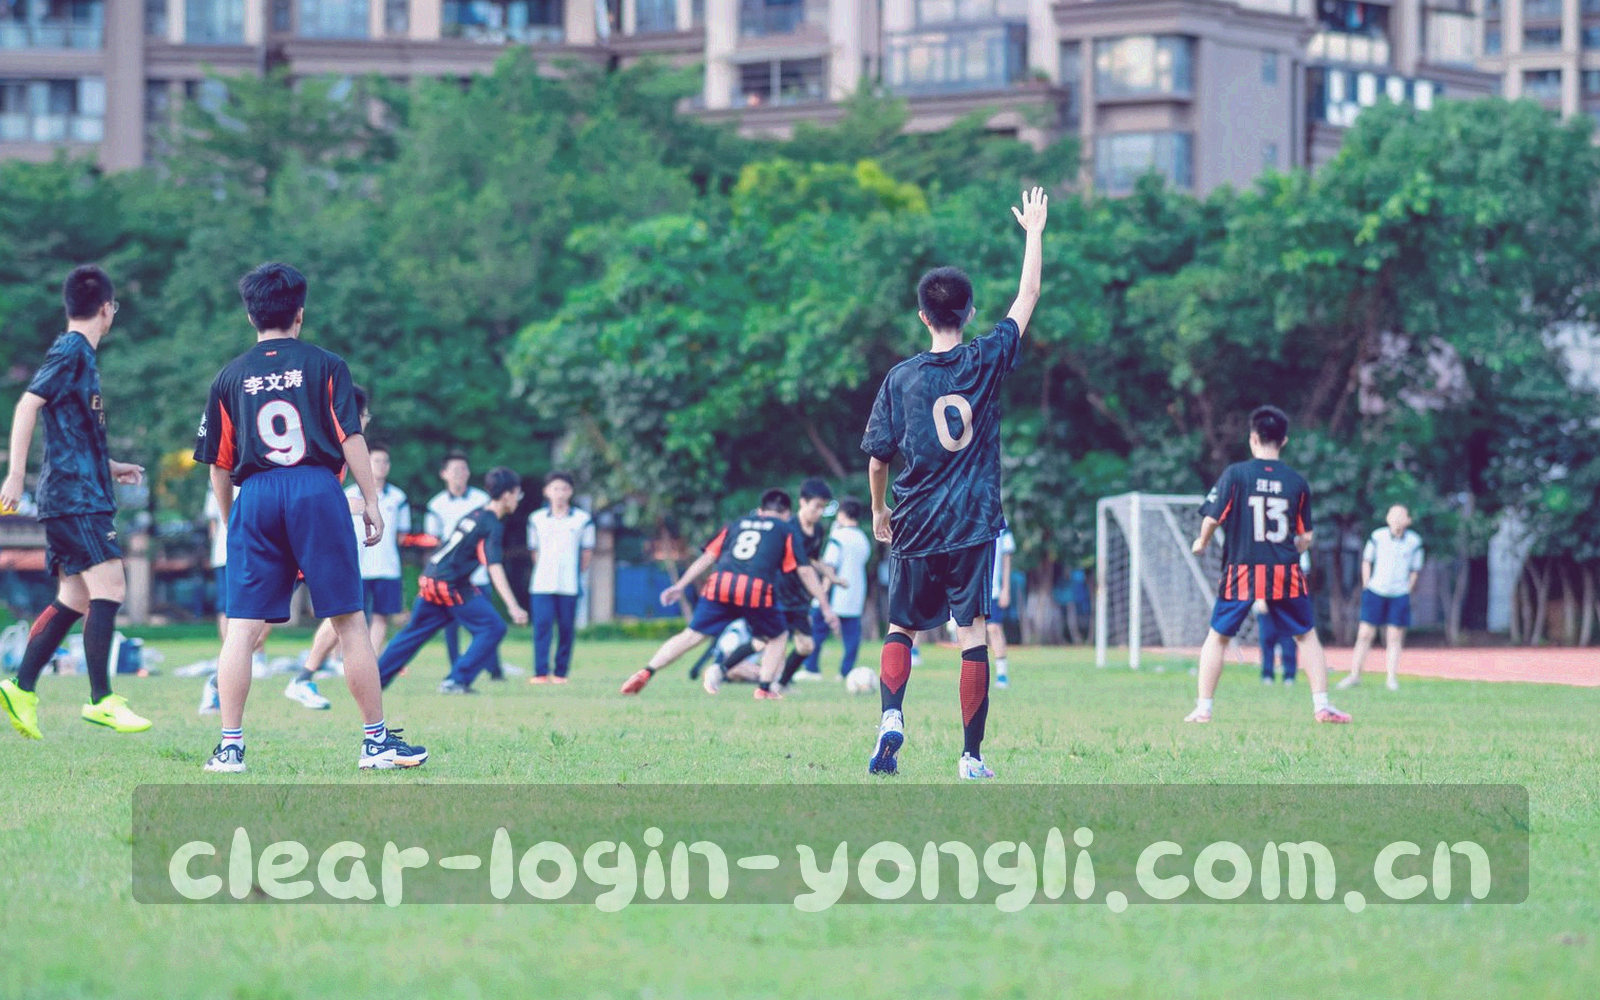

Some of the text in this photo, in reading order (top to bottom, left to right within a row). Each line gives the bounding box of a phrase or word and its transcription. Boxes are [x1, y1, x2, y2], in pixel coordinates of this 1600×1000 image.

[243, 369, 303, 396] 李文涛
[257, 399, 306, 466] 9
[932, 393, 974, 452] 0
[1247, 495, 1289, 543] 13
[732, 530, 762, 560] 8
